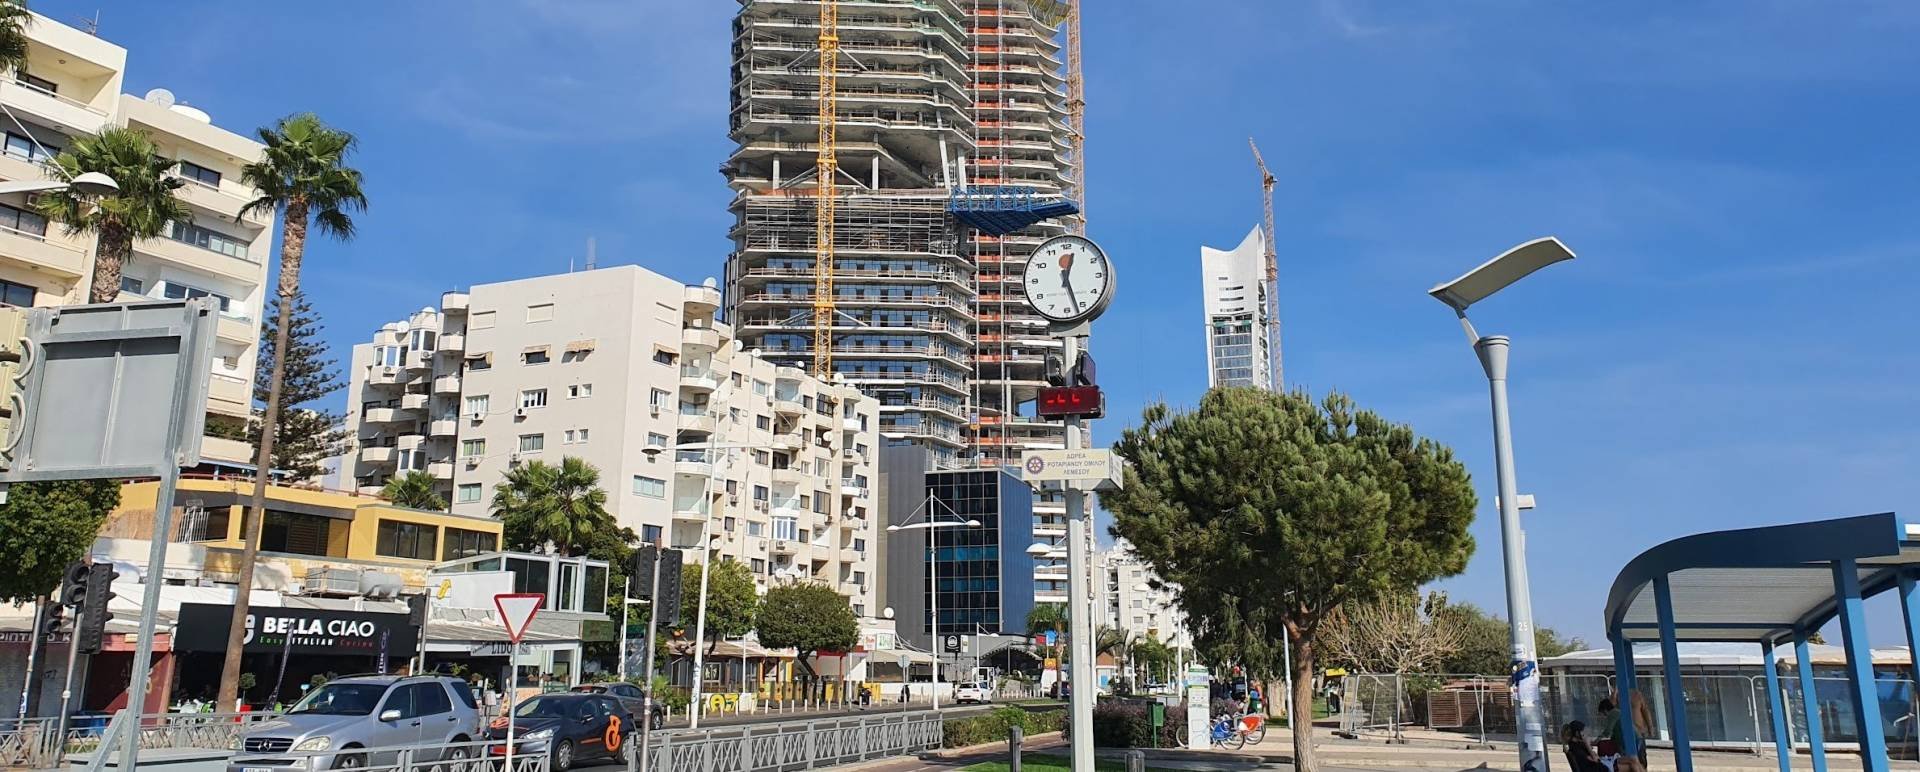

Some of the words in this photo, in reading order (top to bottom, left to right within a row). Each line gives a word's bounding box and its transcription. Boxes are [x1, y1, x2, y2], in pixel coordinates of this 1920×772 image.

[263, 616, 323, 635] BELLA
[327, 619, 375, 637] CIAO
[1518, 621, 1528, 632] 25
[292, 637, 334, 646] ITALIAN
[491, 641, 513, 655] LIDO
